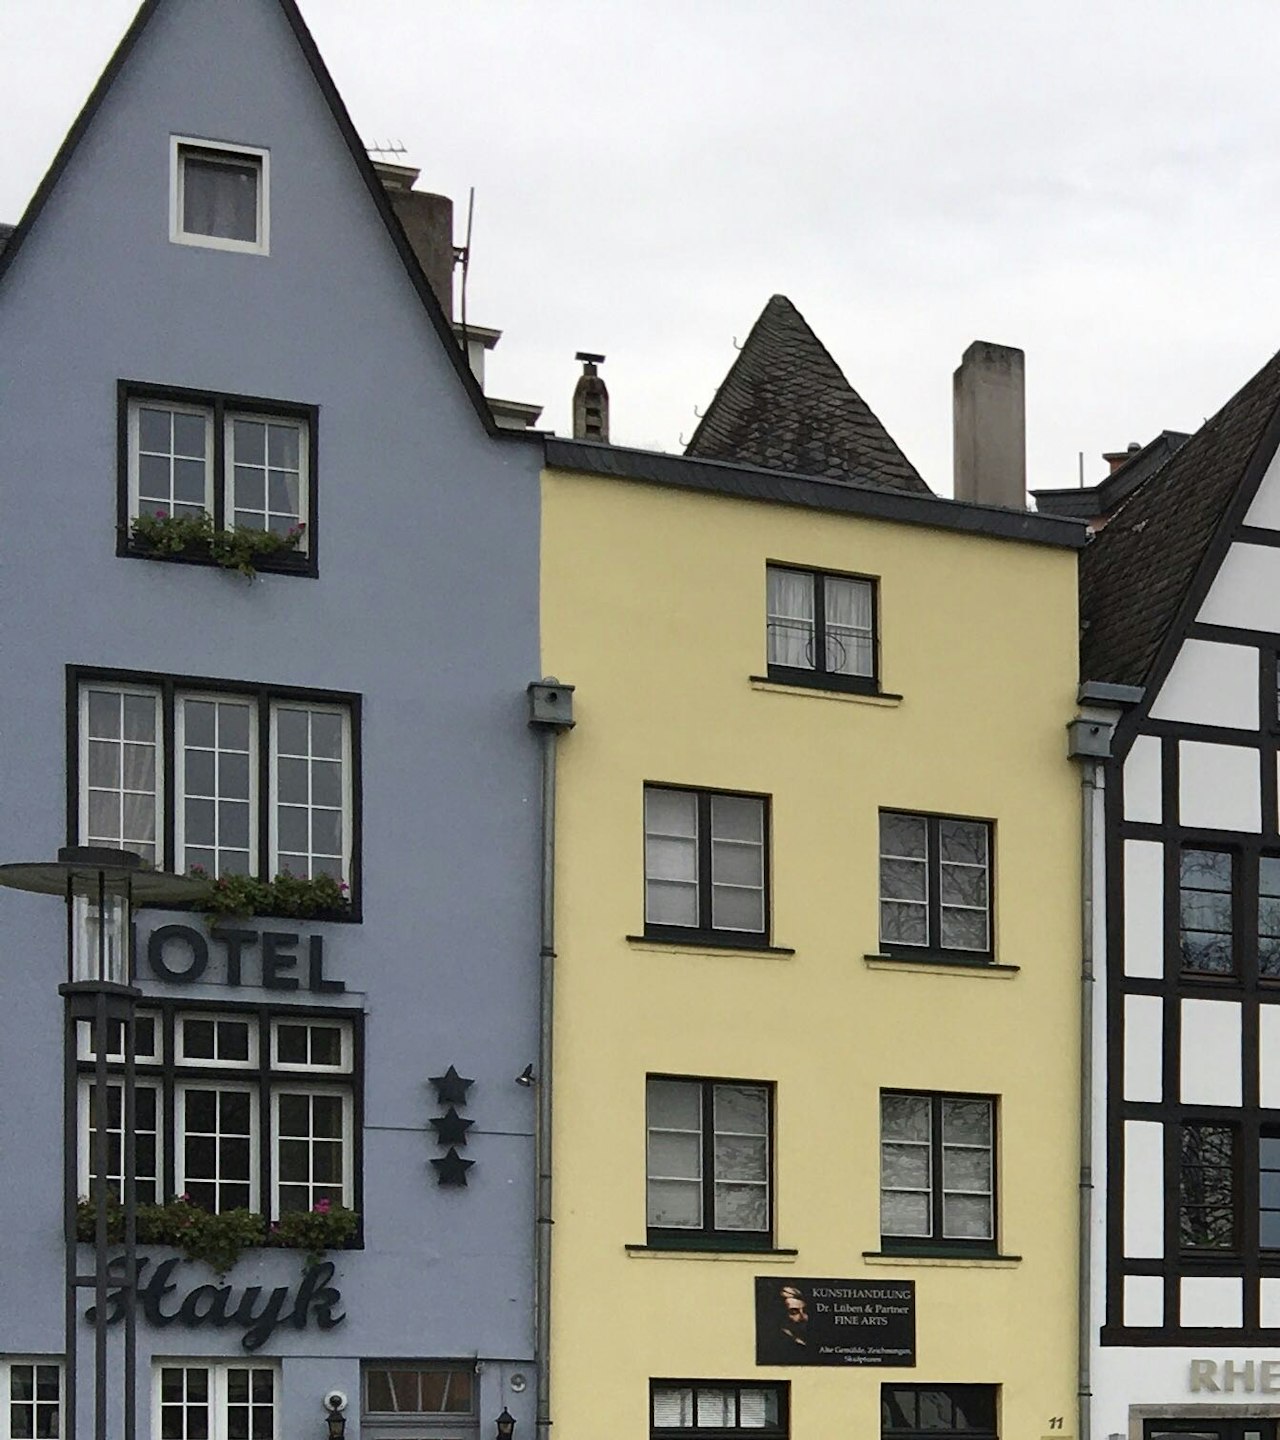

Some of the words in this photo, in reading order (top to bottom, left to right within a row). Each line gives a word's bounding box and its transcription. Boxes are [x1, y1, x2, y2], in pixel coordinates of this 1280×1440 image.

[132, 922, 345, 994] OTEL
[812, 1287, 911, 1300] KUNSTHANDLUNG
[84, 1255, 347, 1350] Hayk
[816, 1302, 831, 1313] Dr.
[833, 1302, 863, 1314] Lüben
[864, 1303, 873, 1314] &
[875, 1304, 910, 1315] Partner
[834, 1315, 859, 1326] FINE
[861, 1316, 888, 1326] ARTS
[1048, 1416, 1064, 1430] 11
